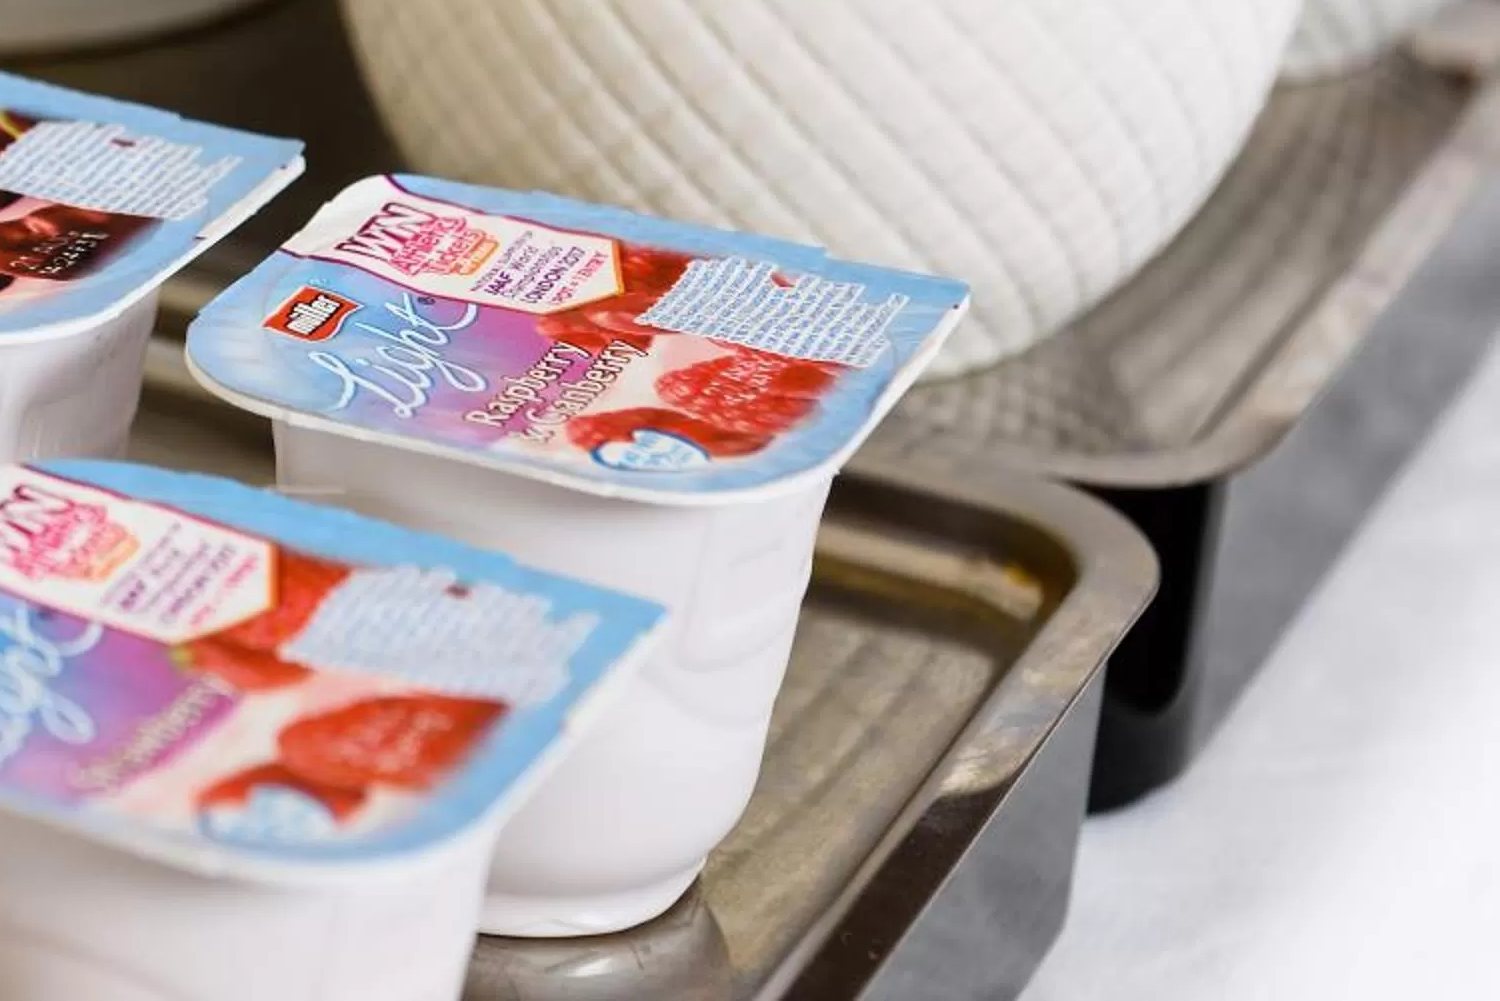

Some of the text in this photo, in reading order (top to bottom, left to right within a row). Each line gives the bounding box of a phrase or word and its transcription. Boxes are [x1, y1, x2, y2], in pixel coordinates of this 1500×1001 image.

[334, 201, 438, 262] WIN
[520, 265, 568, 303] LONDON
[308, 292, 488, 420] Light
[464, 337, 594, 430] Raspberry
[524, 337, 650, 425] Cranberry
